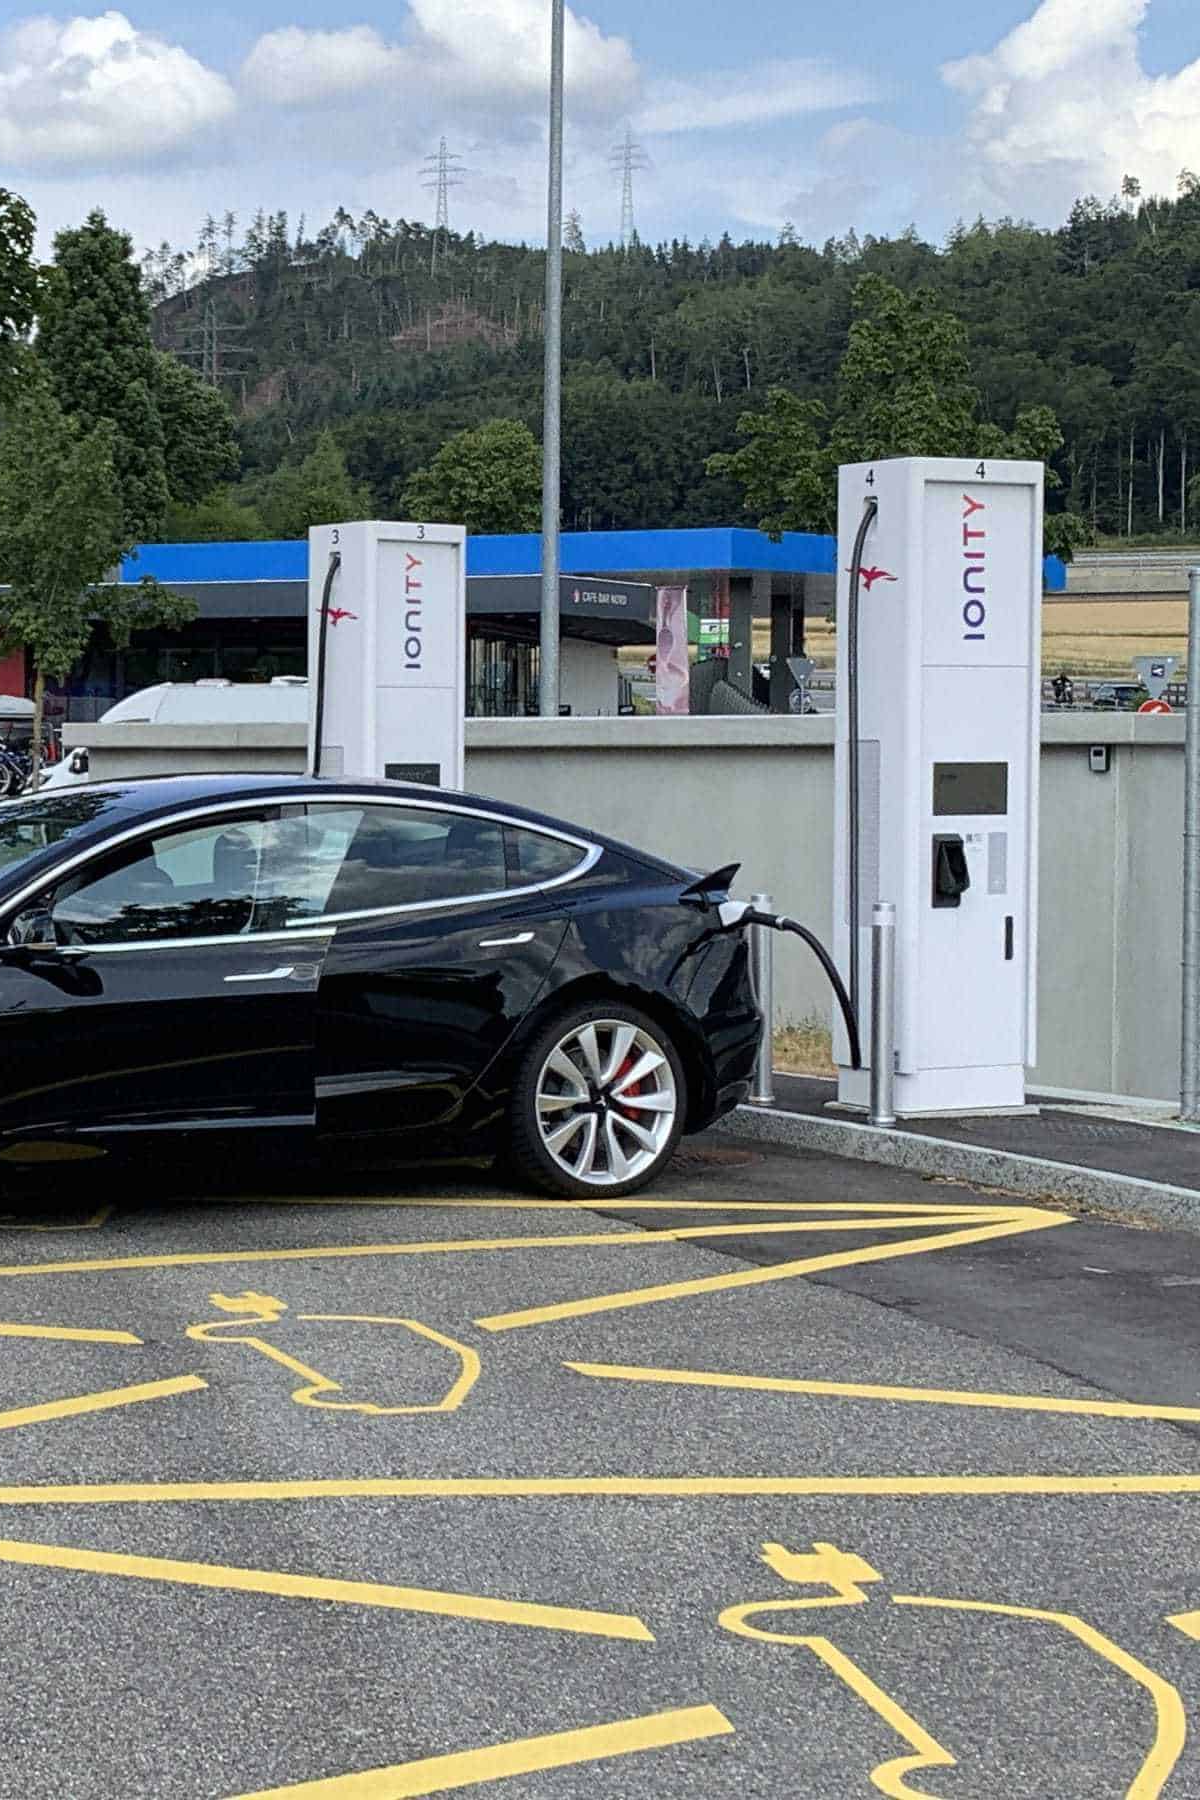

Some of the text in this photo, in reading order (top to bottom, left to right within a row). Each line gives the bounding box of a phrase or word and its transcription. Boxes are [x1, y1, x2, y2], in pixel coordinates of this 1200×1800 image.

[865, 469, 874, 486] 4
[975, 462, 986, 478] 4
[331, 529, 340, 544] 3
[417, 525, 425, 539] 3
[963, 494, 986, 640] IONITY
[404, 552, 423, 669] IONITY
